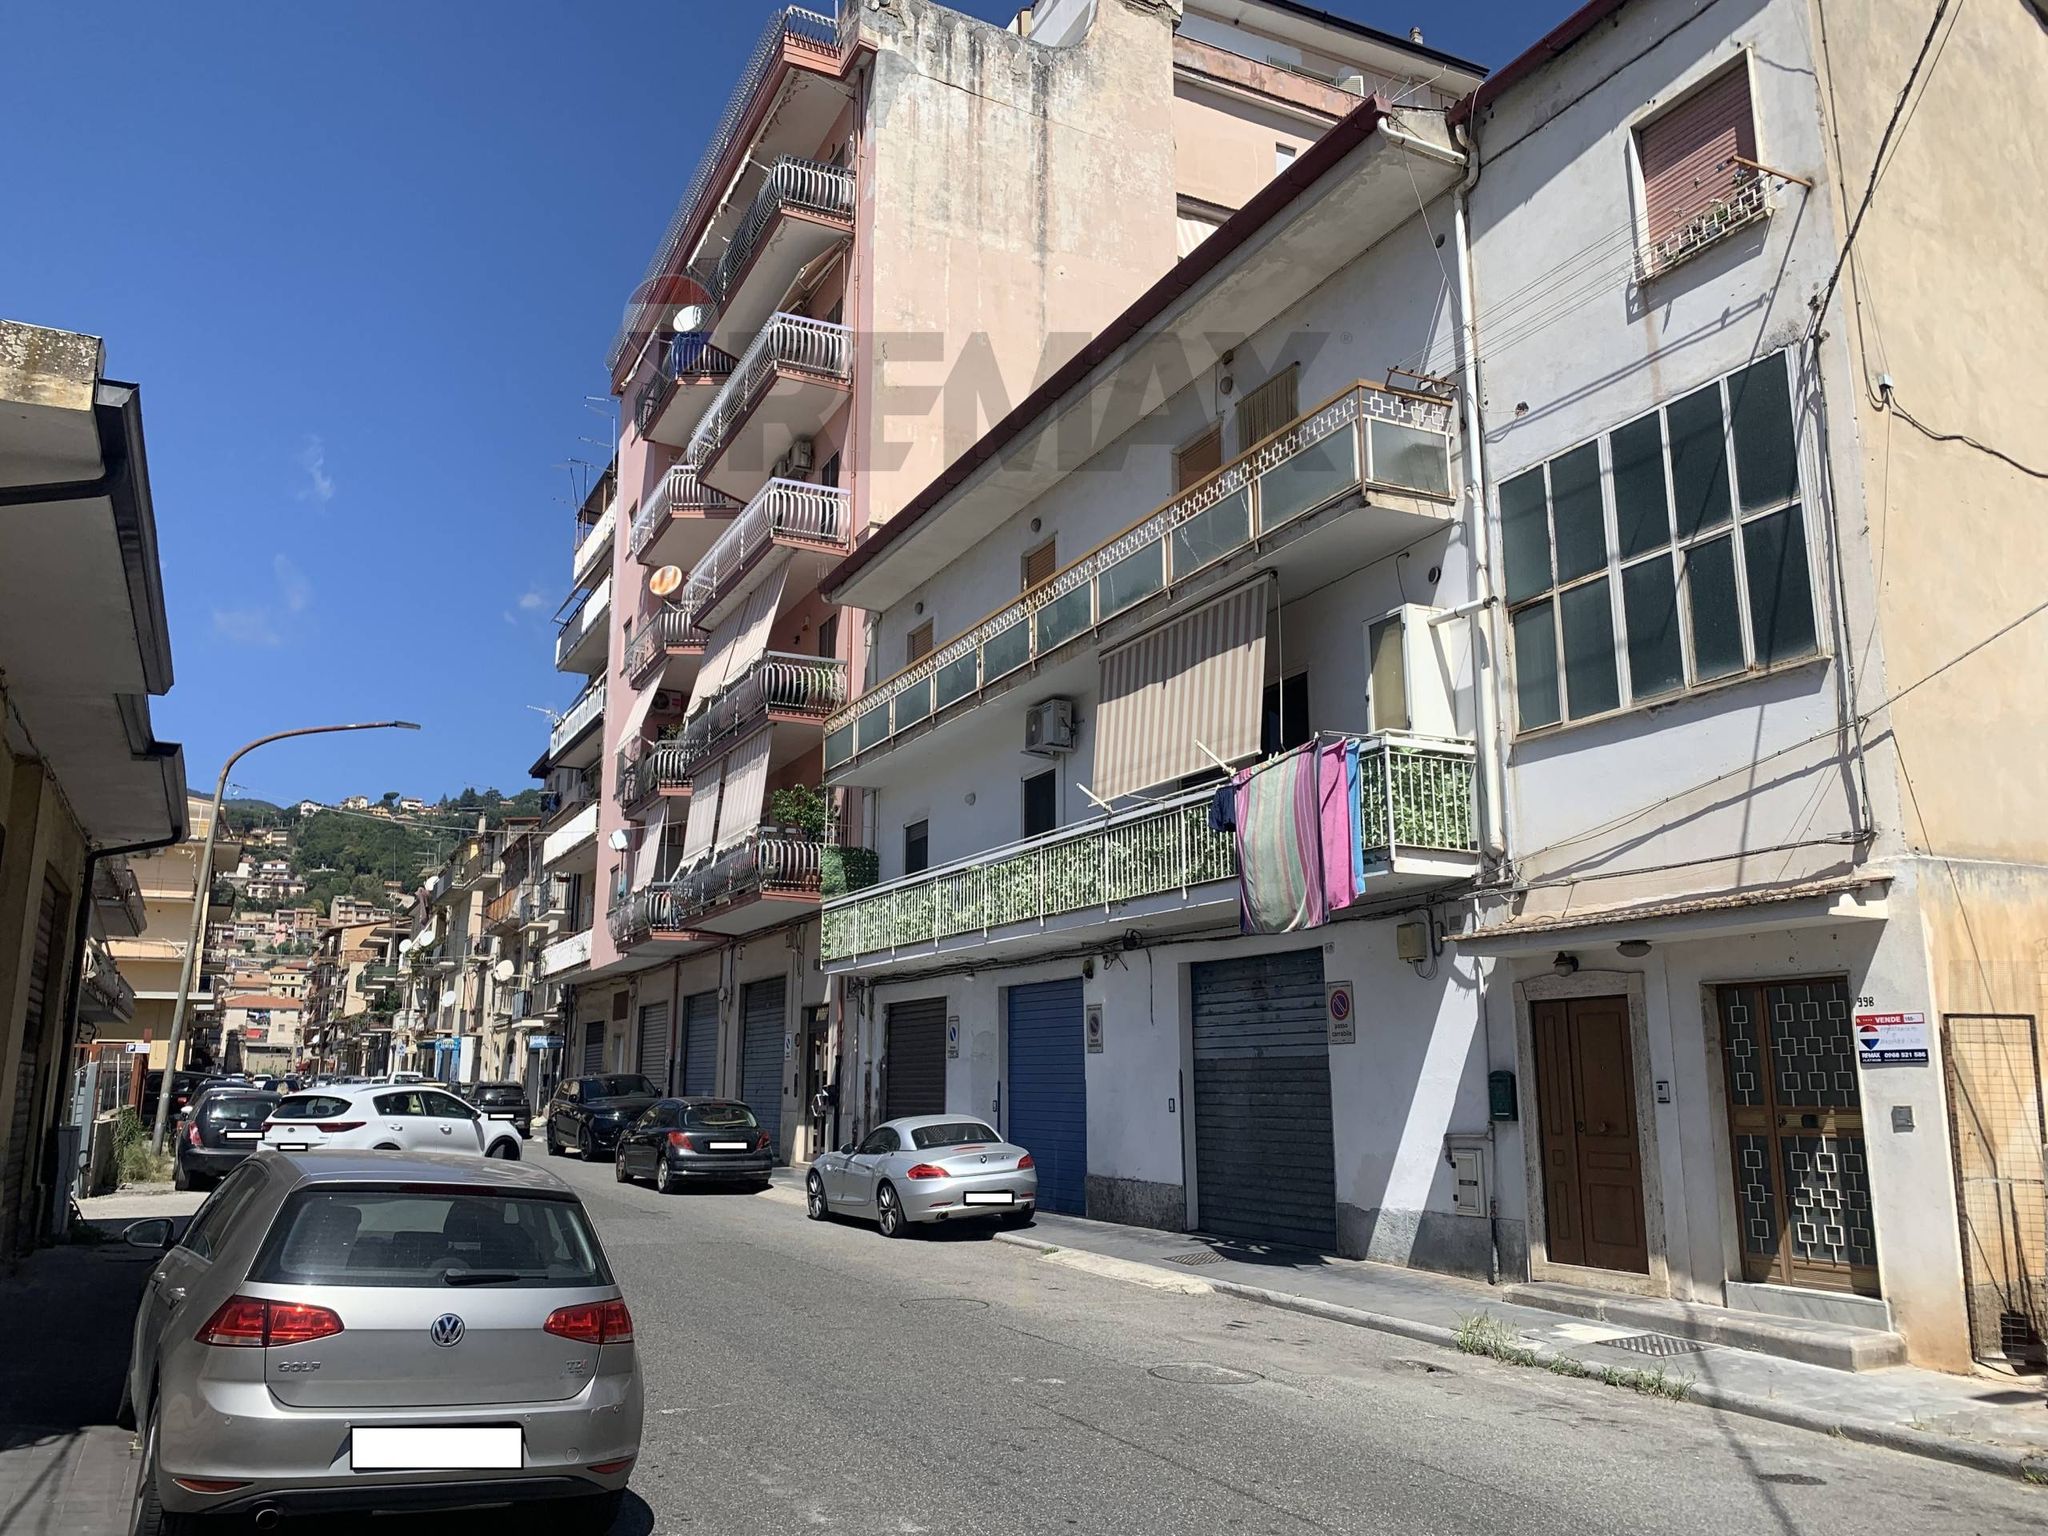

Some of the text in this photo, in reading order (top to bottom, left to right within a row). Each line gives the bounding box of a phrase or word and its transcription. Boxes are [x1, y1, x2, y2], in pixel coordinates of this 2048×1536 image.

[1856, 996, 1875, 1008] 998
[1875, 1016, 1901, 1024] VENDE
[278, 1361, 321, 1373] GOLF
